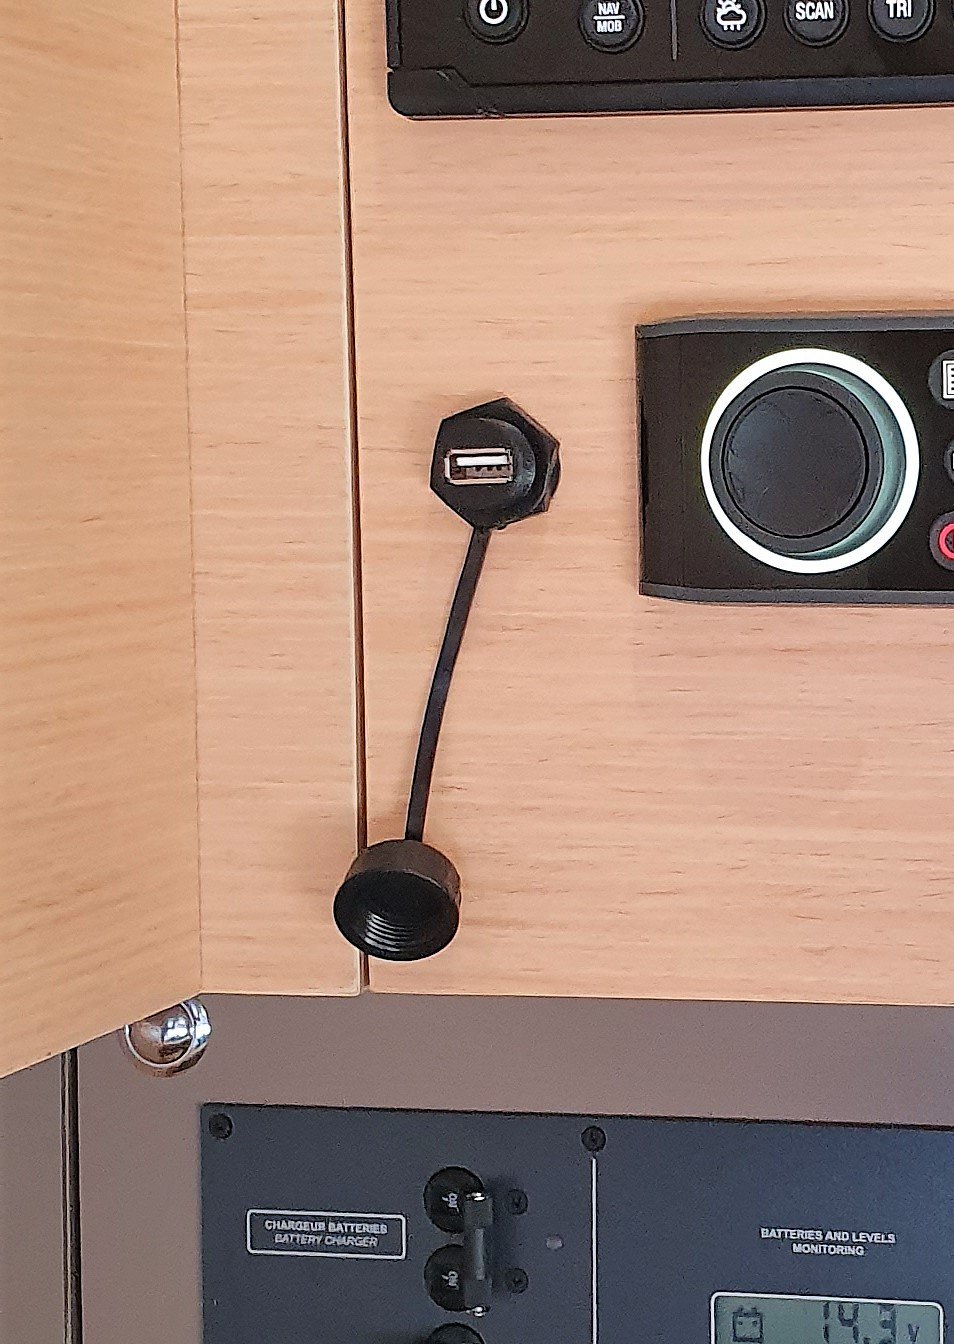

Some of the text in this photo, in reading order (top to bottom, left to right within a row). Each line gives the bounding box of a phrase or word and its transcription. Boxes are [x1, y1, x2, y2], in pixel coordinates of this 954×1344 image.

[597, 1, 620, 15] NAV
[795, 1, 834, 22] SCAN
[597, 19, 623, 34] MOB
[264, 1219, 388, 1234] CHARGEUR BATTERIES
[274, 1233, 378, 1248] BATTERY CHARGER
[761, 1227, 896, 1244] BATTERIES AND LEVELS
[792, 1243, 865, 1256] MONITORING
